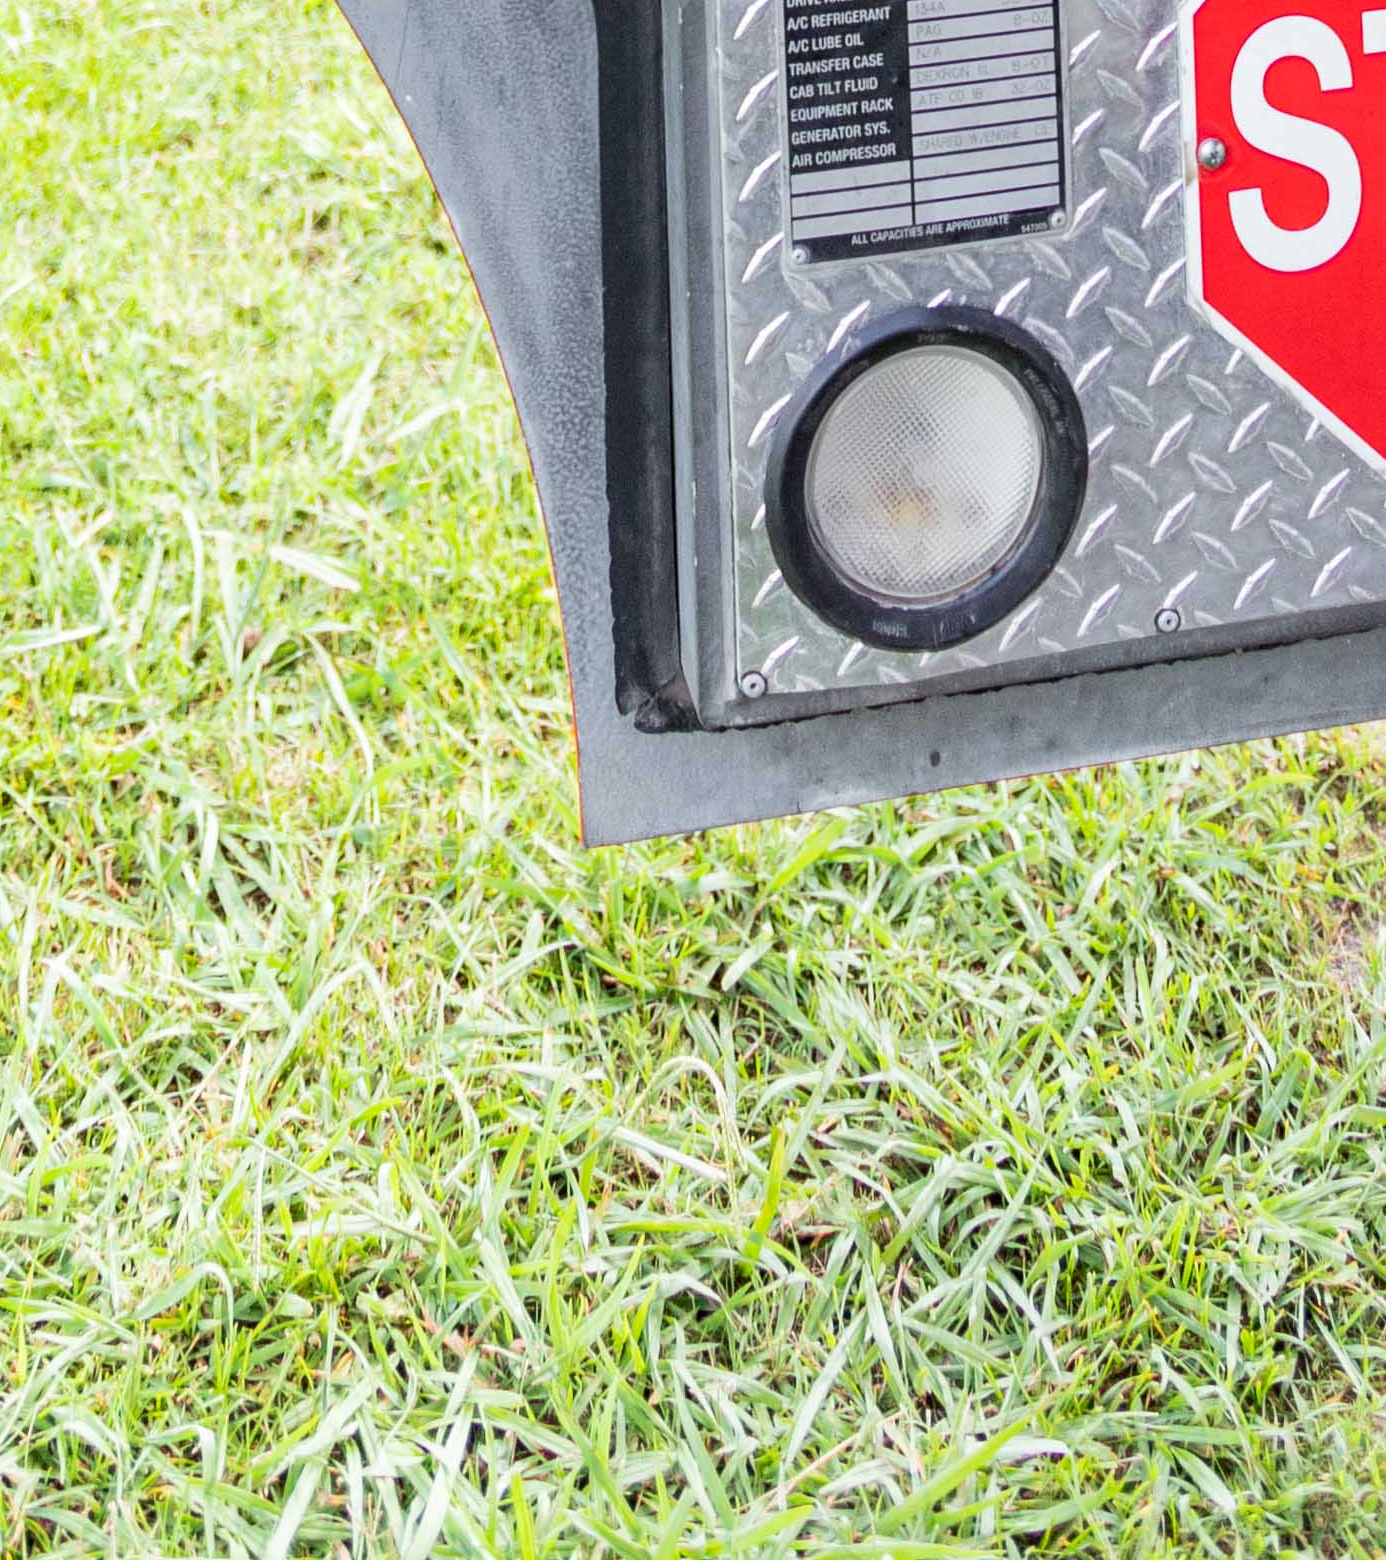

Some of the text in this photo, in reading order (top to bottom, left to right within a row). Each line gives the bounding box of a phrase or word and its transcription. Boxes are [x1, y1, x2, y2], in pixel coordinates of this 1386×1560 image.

[787, 7, 891, 31] A/C REFRIGERANT
[788, 32, 864, 54] A/C LUBE OIL
[789, 53, 884, 76] TRANSFER CASE
[789, 77, 878, 100] CAB TILT FLUID
[791, 98, 894, 122] EQUIPMENT RACK
[791, 121, 891, 145] GENERATOR SYS.
[792, 143, 896, 168] AIR COMPRESSOR
[851, 234, 868, 246] ALL
[871, 225, 923, 243] CAPACITIES
[925, 222, 943, 235] ARE
[946, 214, 1010, 233] APPROXIMATE
